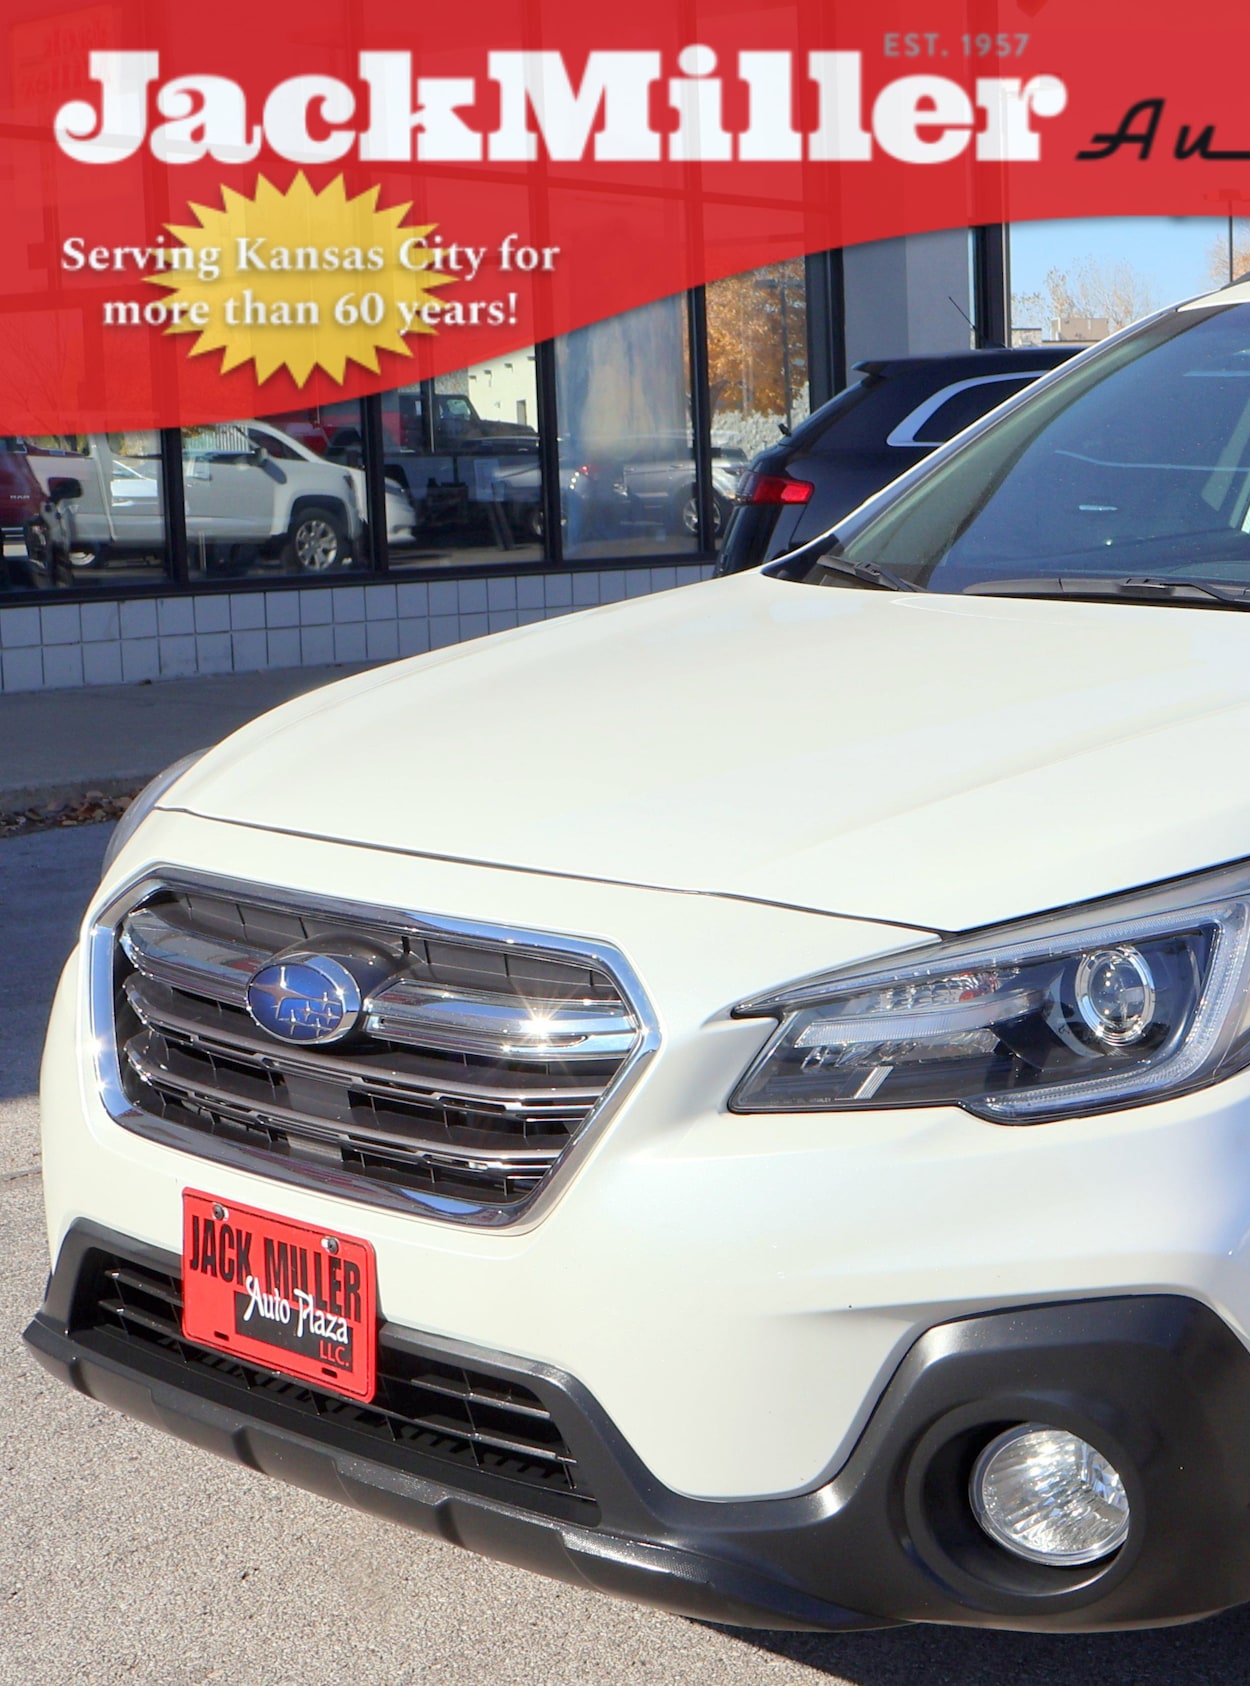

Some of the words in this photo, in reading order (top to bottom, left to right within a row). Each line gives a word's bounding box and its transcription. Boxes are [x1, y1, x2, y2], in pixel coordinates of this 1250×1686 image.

[189, 1214, 252, 1286] JACK
[263, 1236, 362, 1324] MILLER
[243, 1275, 292, 1324] Auto
[293, 1287, 349, 1345] Plaza
[318, 1339, 350, 1367] LLC.
